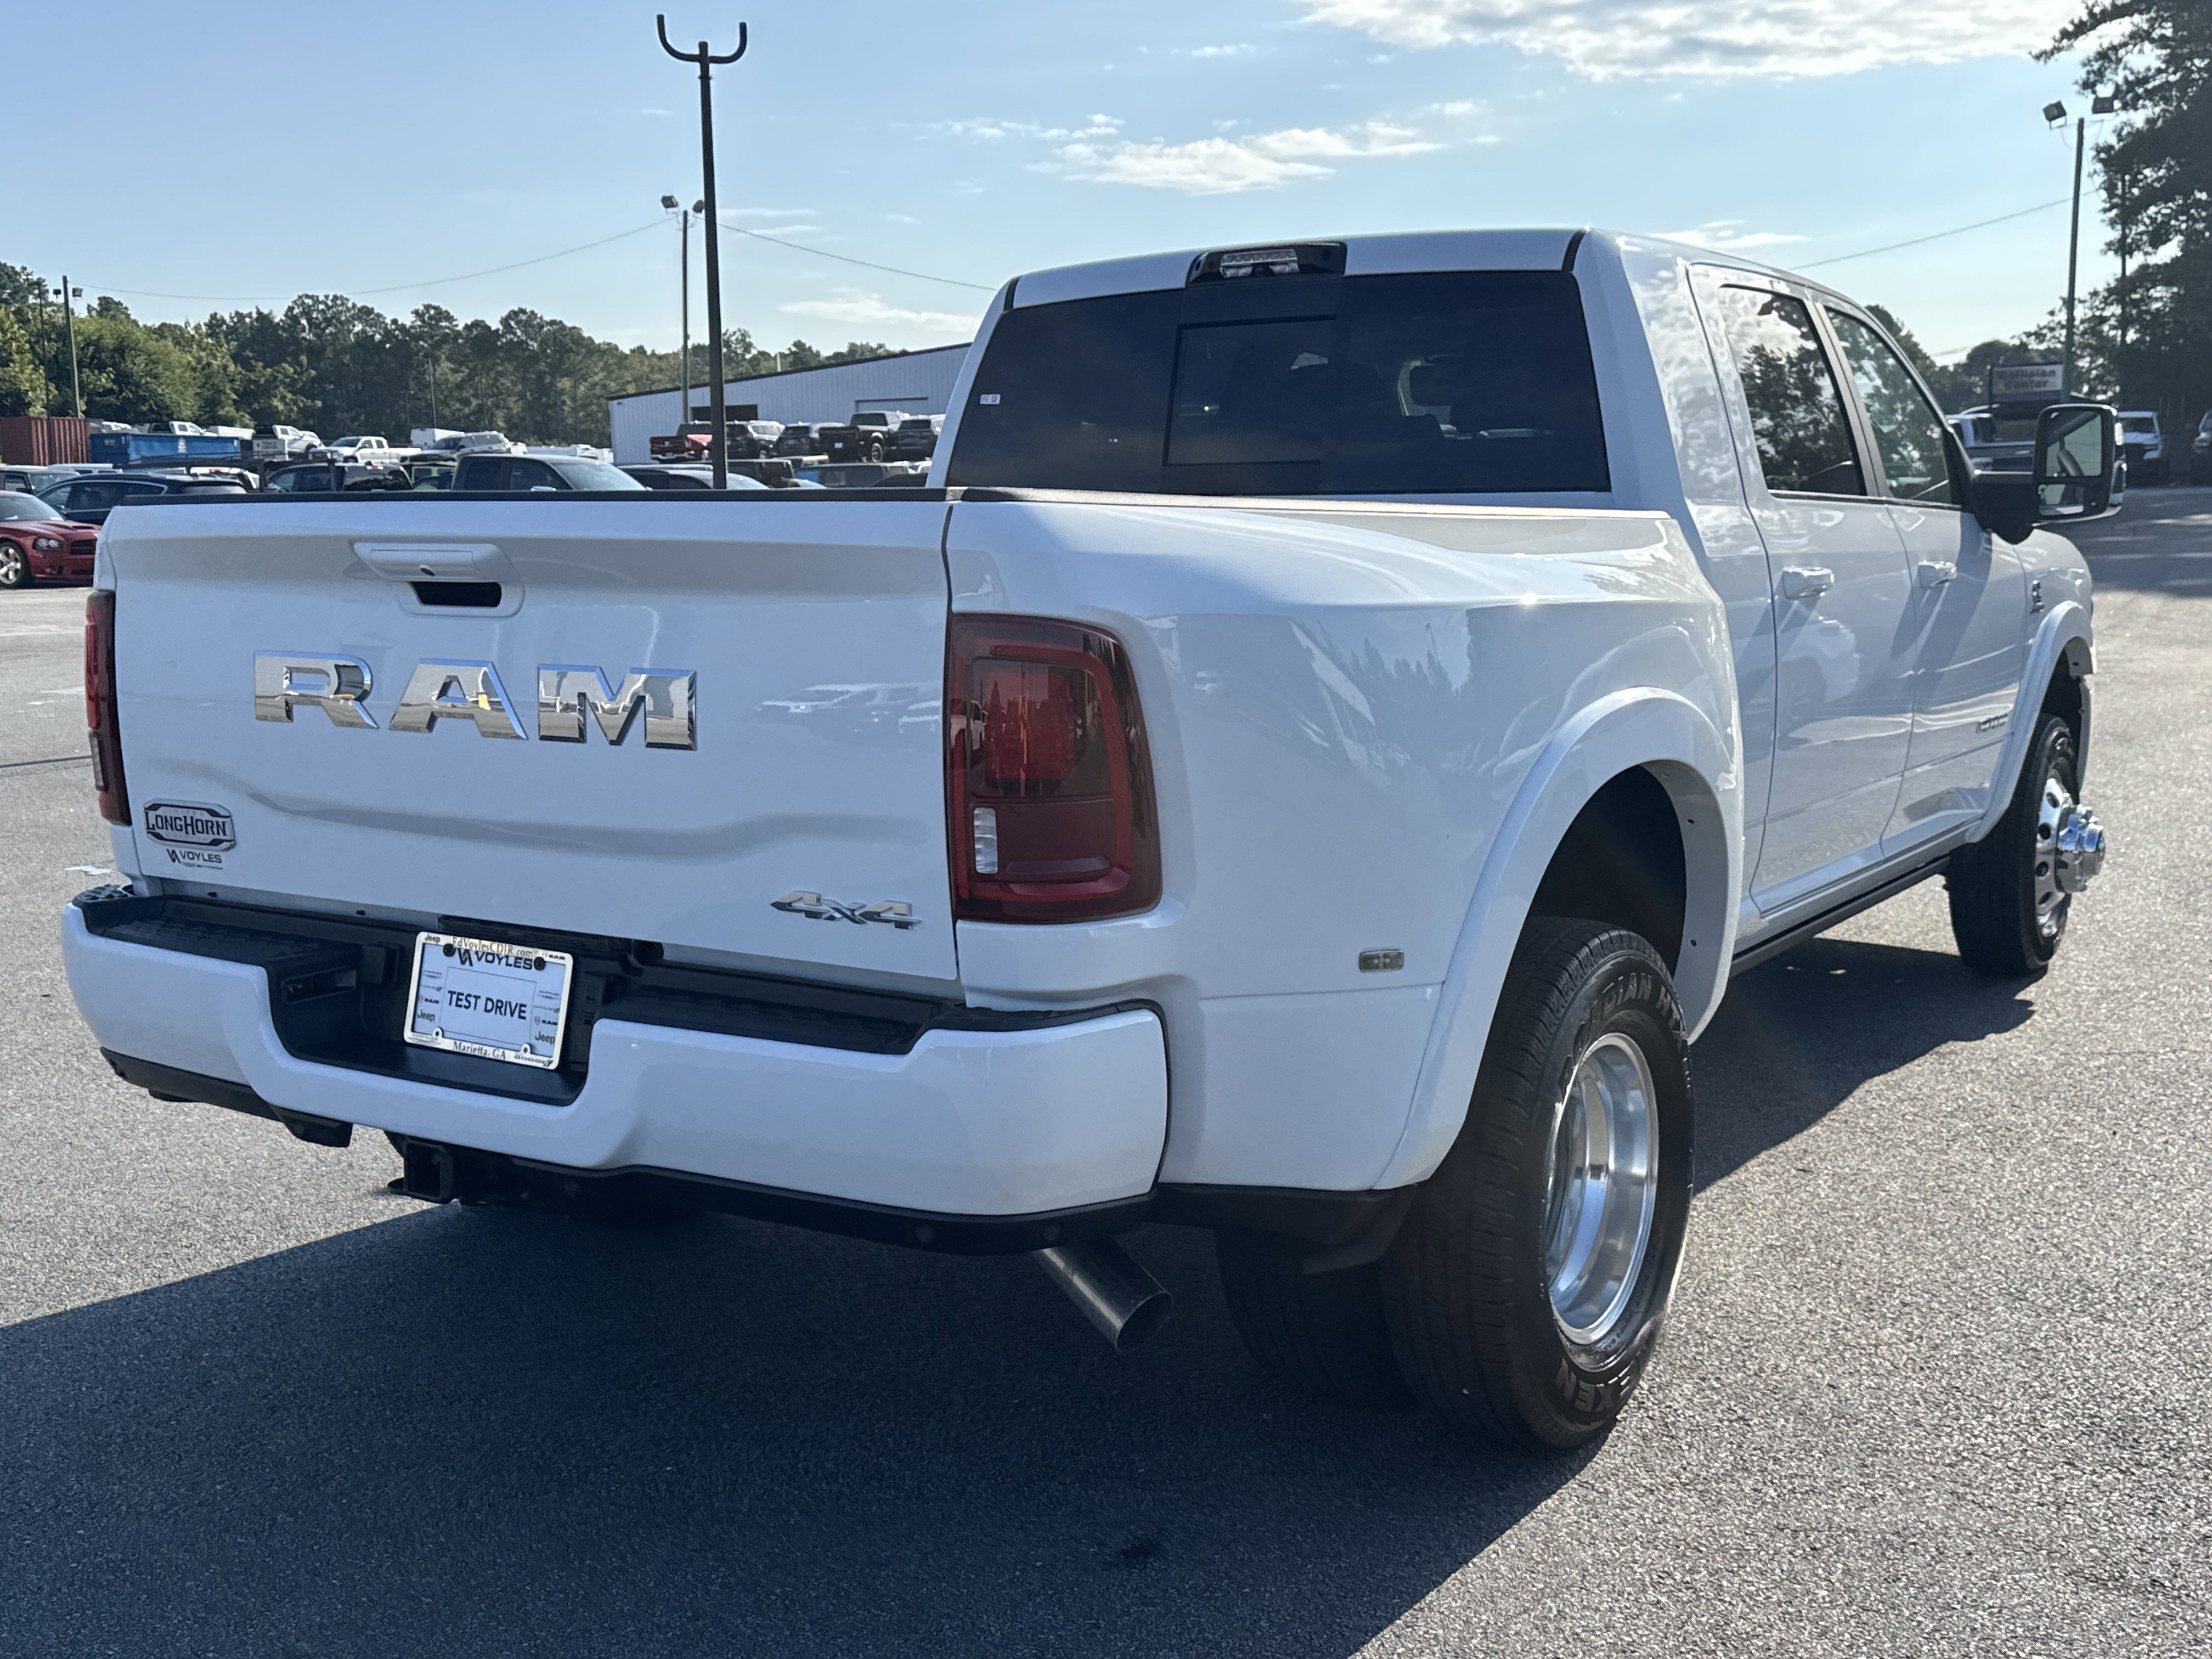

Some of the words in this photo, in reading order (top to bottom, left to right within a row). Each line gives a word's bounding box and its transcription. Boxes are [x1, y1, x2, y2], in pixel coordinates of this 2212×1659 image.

[253, 650, 698, 751] RAM
[179, 850, 222, 864] VOYLES
[424, 934, 441, 944] Jeep
[475, 950, 533, 970] VOYLES
[448, 990, 481, 1011] TEST
[484, 997, 527, 1020] DRIVE
[417, 1009, 435, 1023] Jeep
[534, 1031, 556, 1045] Jeep
[453, 1040, 490, 1057] Marietta,
[492, 1049, 506, 1060] GA
